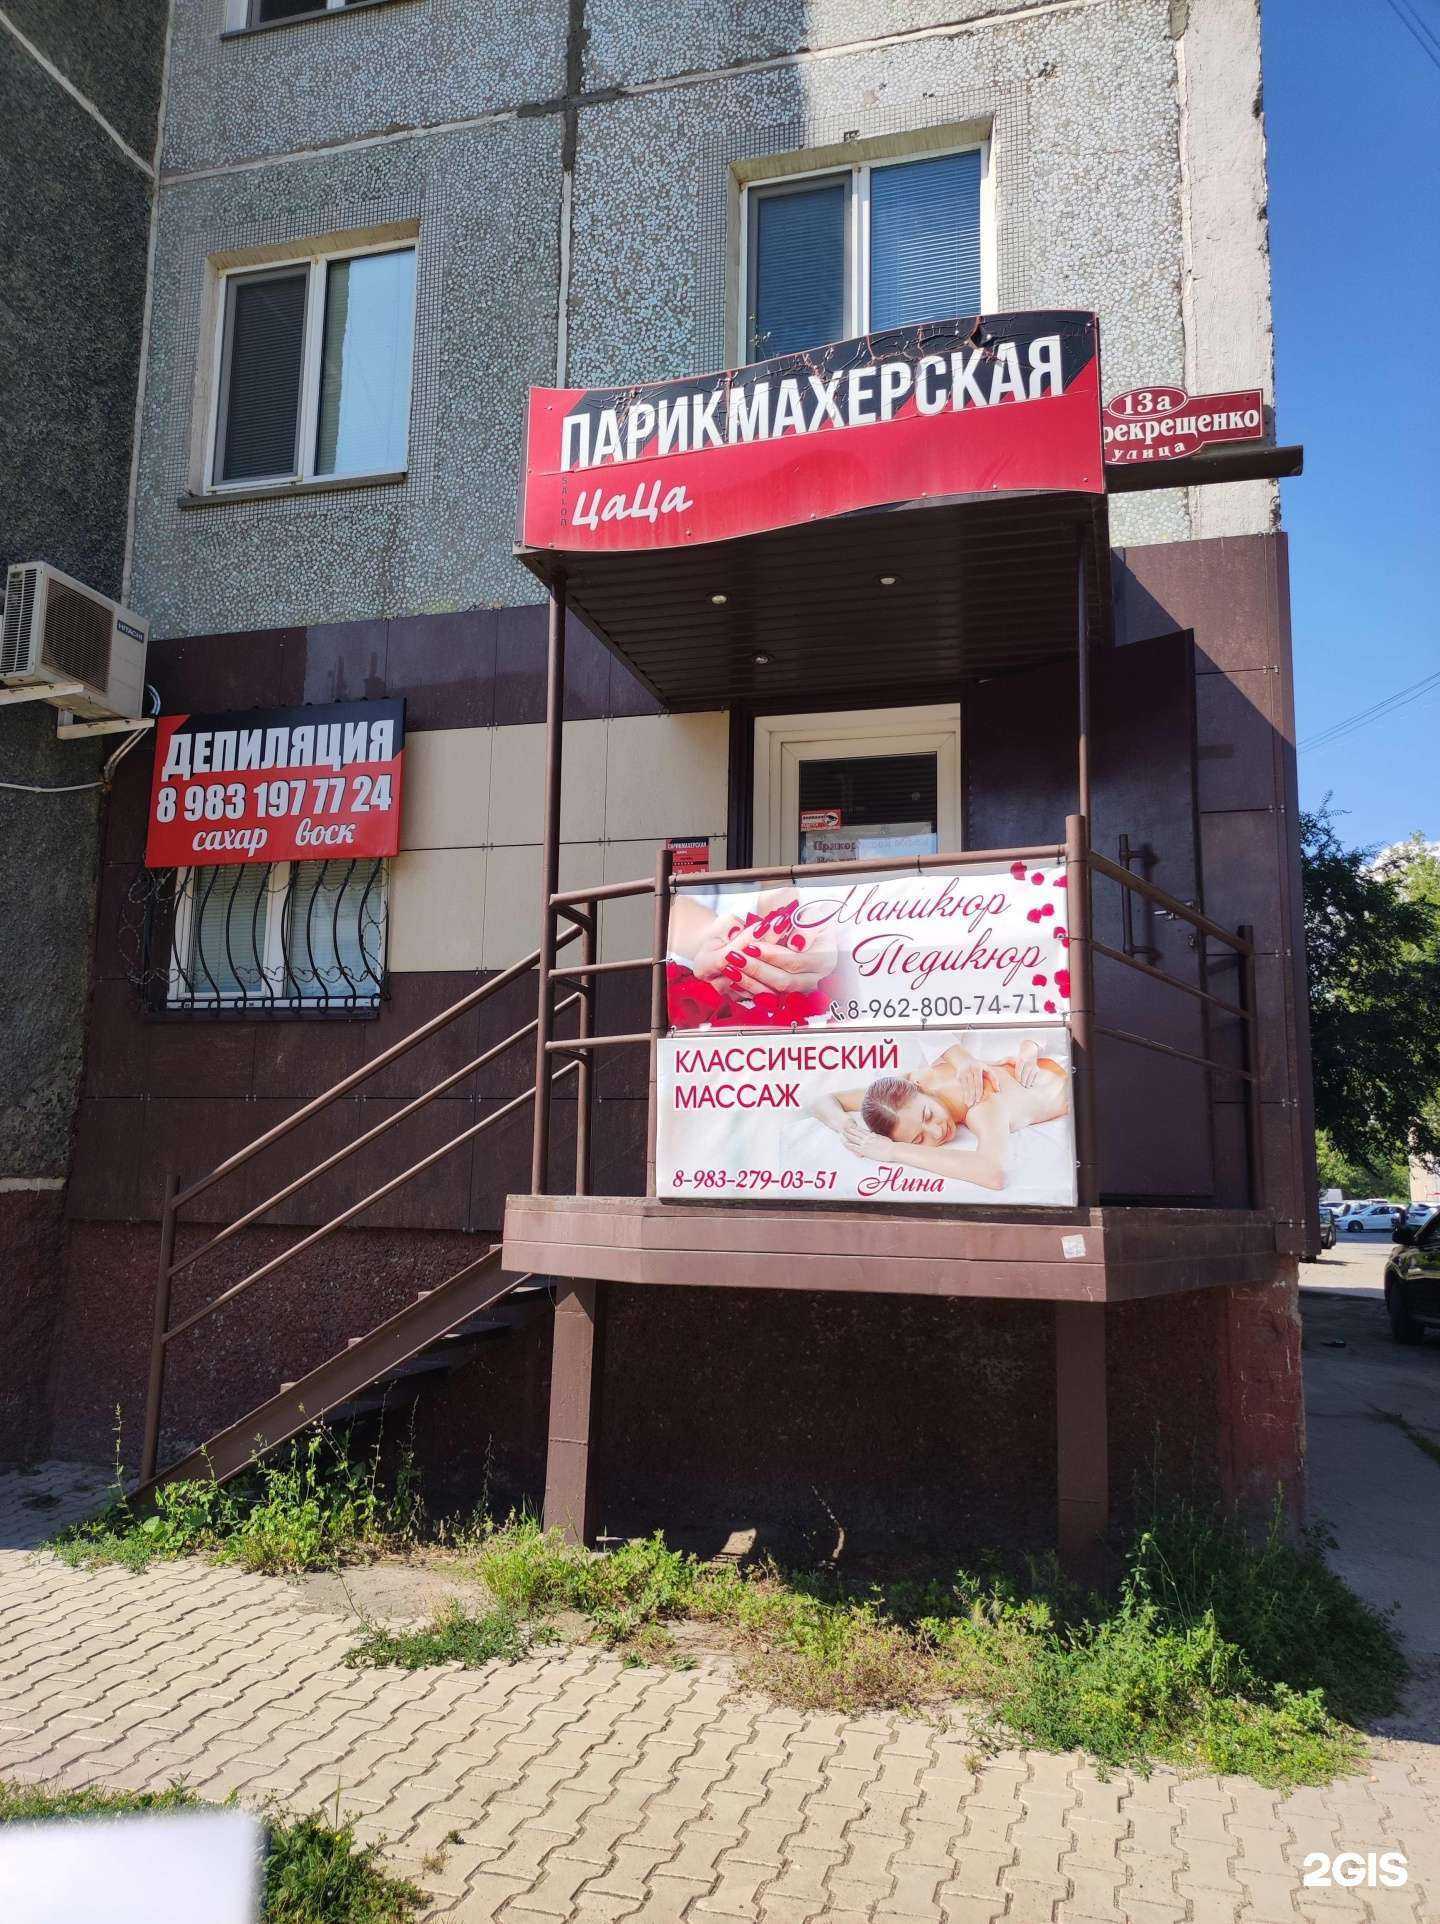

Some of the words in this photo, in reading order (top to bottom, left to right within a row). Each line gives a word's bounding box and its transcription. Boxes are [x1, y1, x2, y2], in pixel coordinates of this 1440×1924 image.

[560, 335, 1064, 472] ПАРИКМАХЕРСКАЯ
[1123, 392, 1173, 416] 13а
[1111, 442, 1186, 462] улица
[571, 479, 694, 531] ЦаЦа
[118, 622, 144, 640] HITACHI
[161, 719, 395, 782] ДЕПИЛЯЦИЯ
[157, 786, 178, 823] 8
[184, 782, 246, 821] 983
[253, 779, 307, 818] 197
[312, 776, 347, 814] 77
[351, 774, 392, 813] 24
[192, 826, 269, 857] сахар
[295, 817, 358, 847] воск
[793, 877, 1012, 933] Маникюр
[852, 928, 1047, 990] Педикюр
[848, 994, 1040, 1019] 8-962-800-74-71
[675, 1038, 899, 1073] КЛАССИЧЕСКИЙ
[675, 1083, 801, 1109] МАССАЖ
[672, 1169, 838, 1190] 8-983-279-03-51
[857, 1165, 945, 1197] Нина
